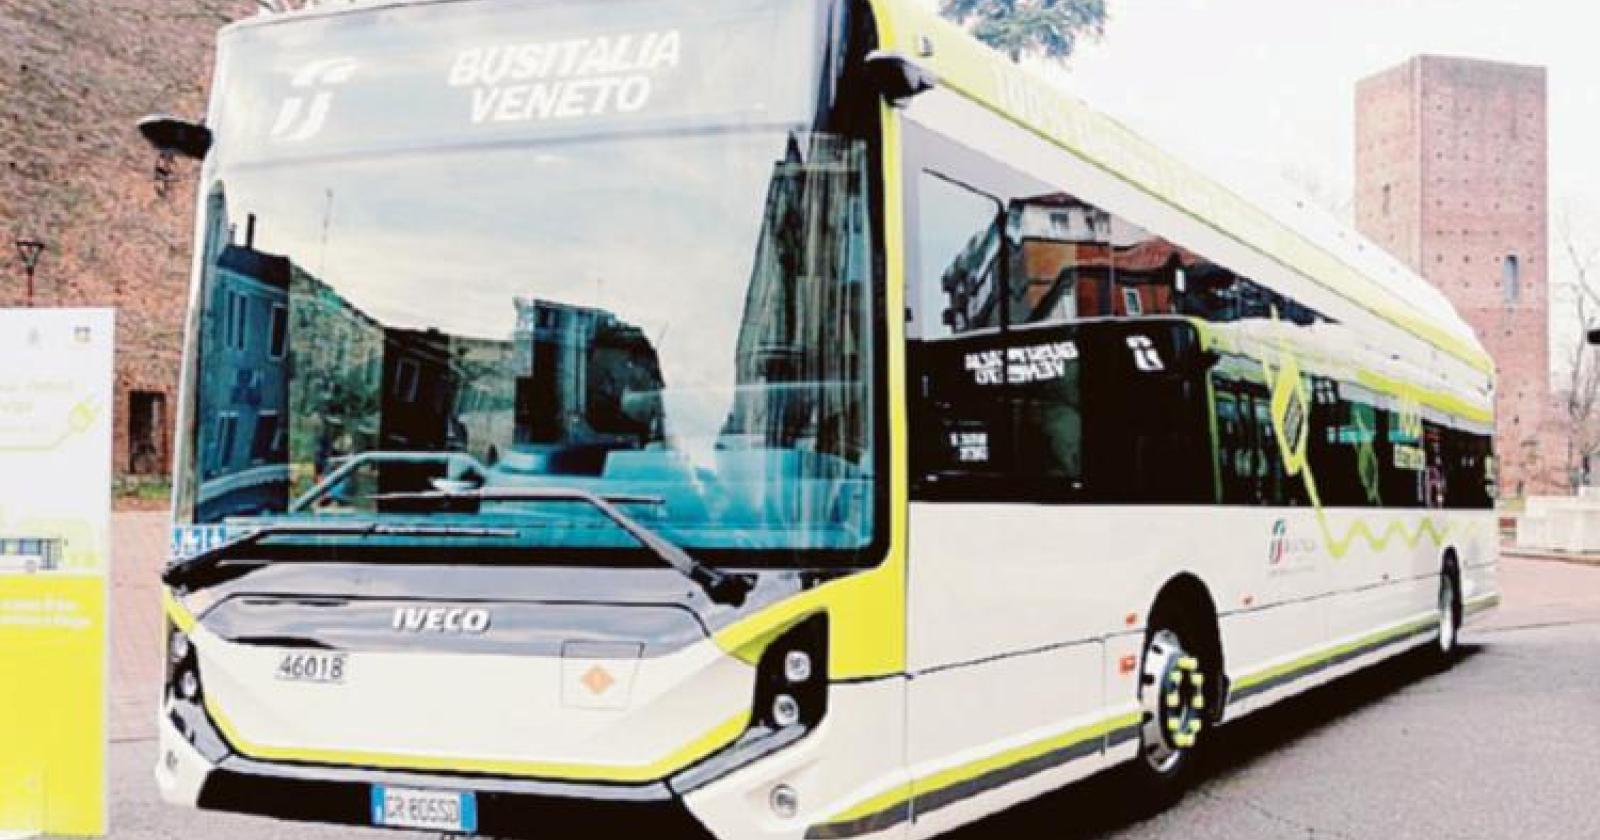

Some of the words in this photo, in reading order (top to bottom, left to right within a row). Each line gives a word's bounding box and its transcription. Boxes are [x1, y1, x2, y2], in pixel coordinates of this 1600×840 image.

[448, 30, 681, 86] BUSITALIA
[472, 76, 651, 124] VENETO
[392, 607, 491, 632] IVECO
[279, 654, 344, 680] 46018
